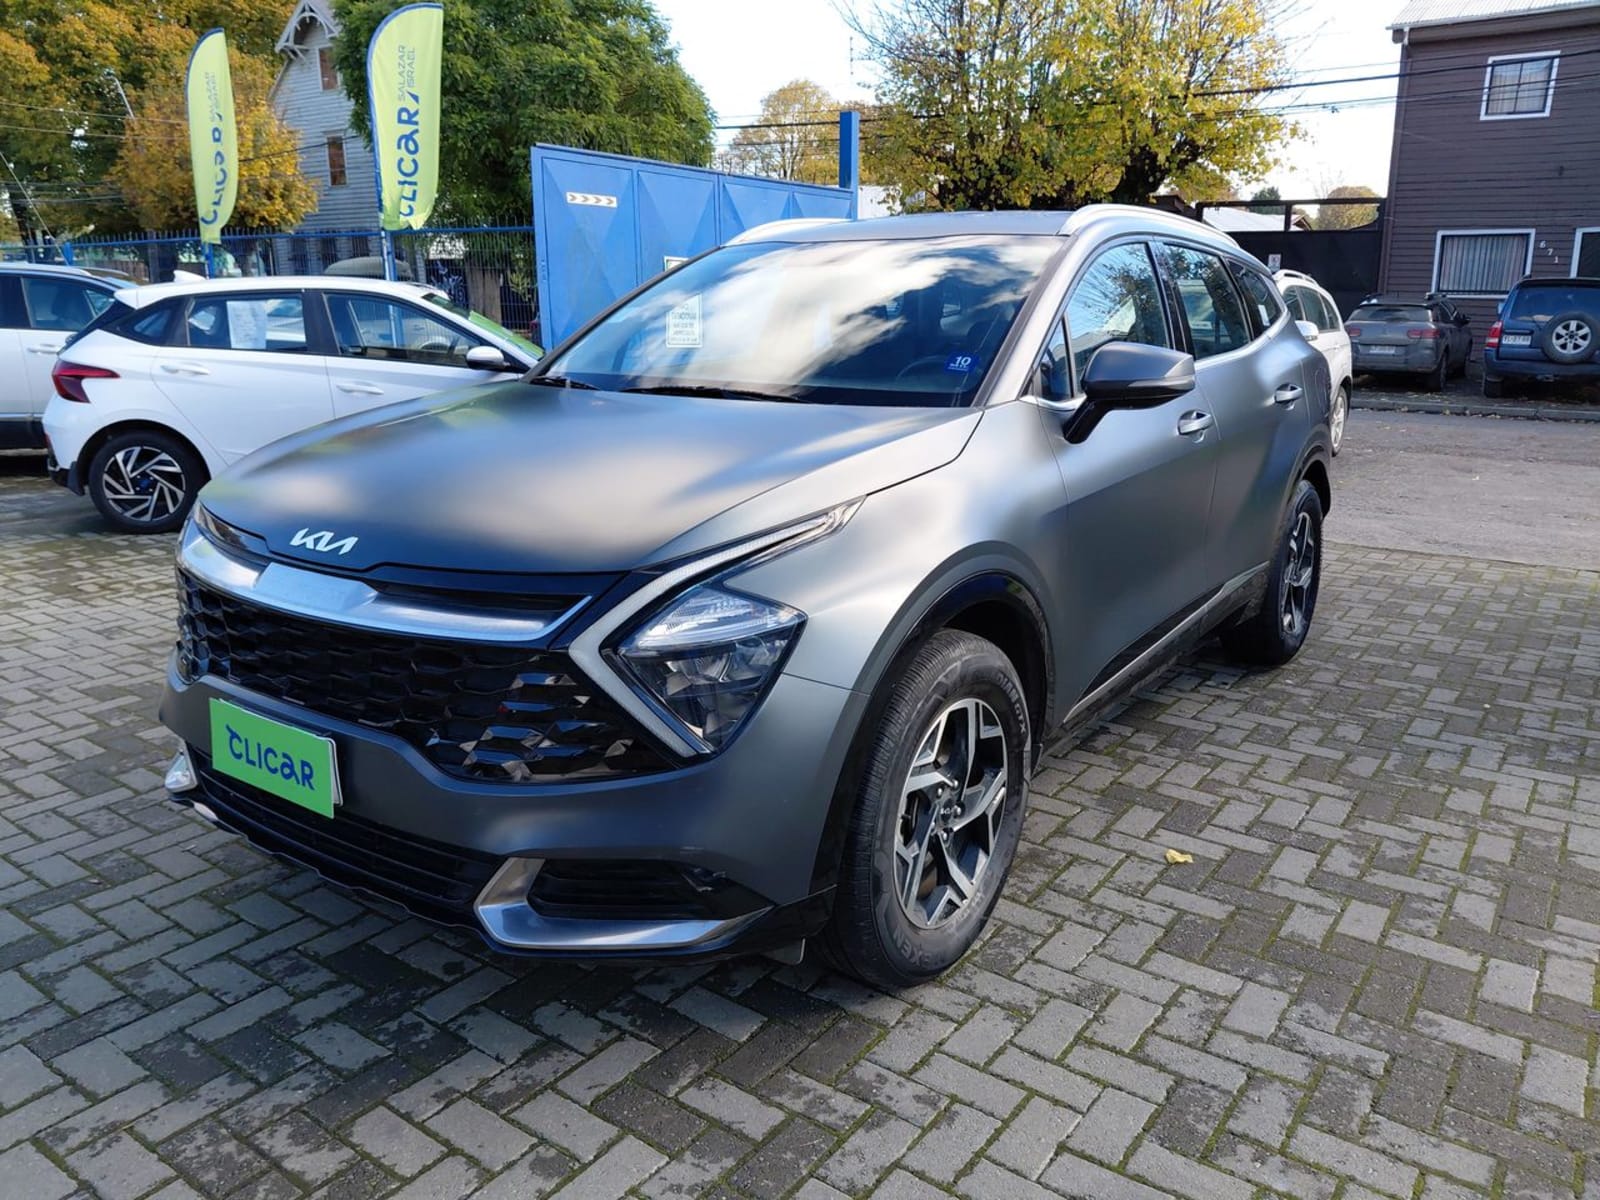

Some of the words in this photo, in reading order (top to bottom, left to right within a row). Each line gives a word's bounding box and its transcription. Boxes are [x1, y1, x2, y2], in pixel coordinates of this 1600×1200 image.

[398, 44, 406, 102] SALAZAR
[406, 47, 415, 88] ISRAEL
[954, 356, 971, 367] 10
[290, 528, 359, 555] KIA
